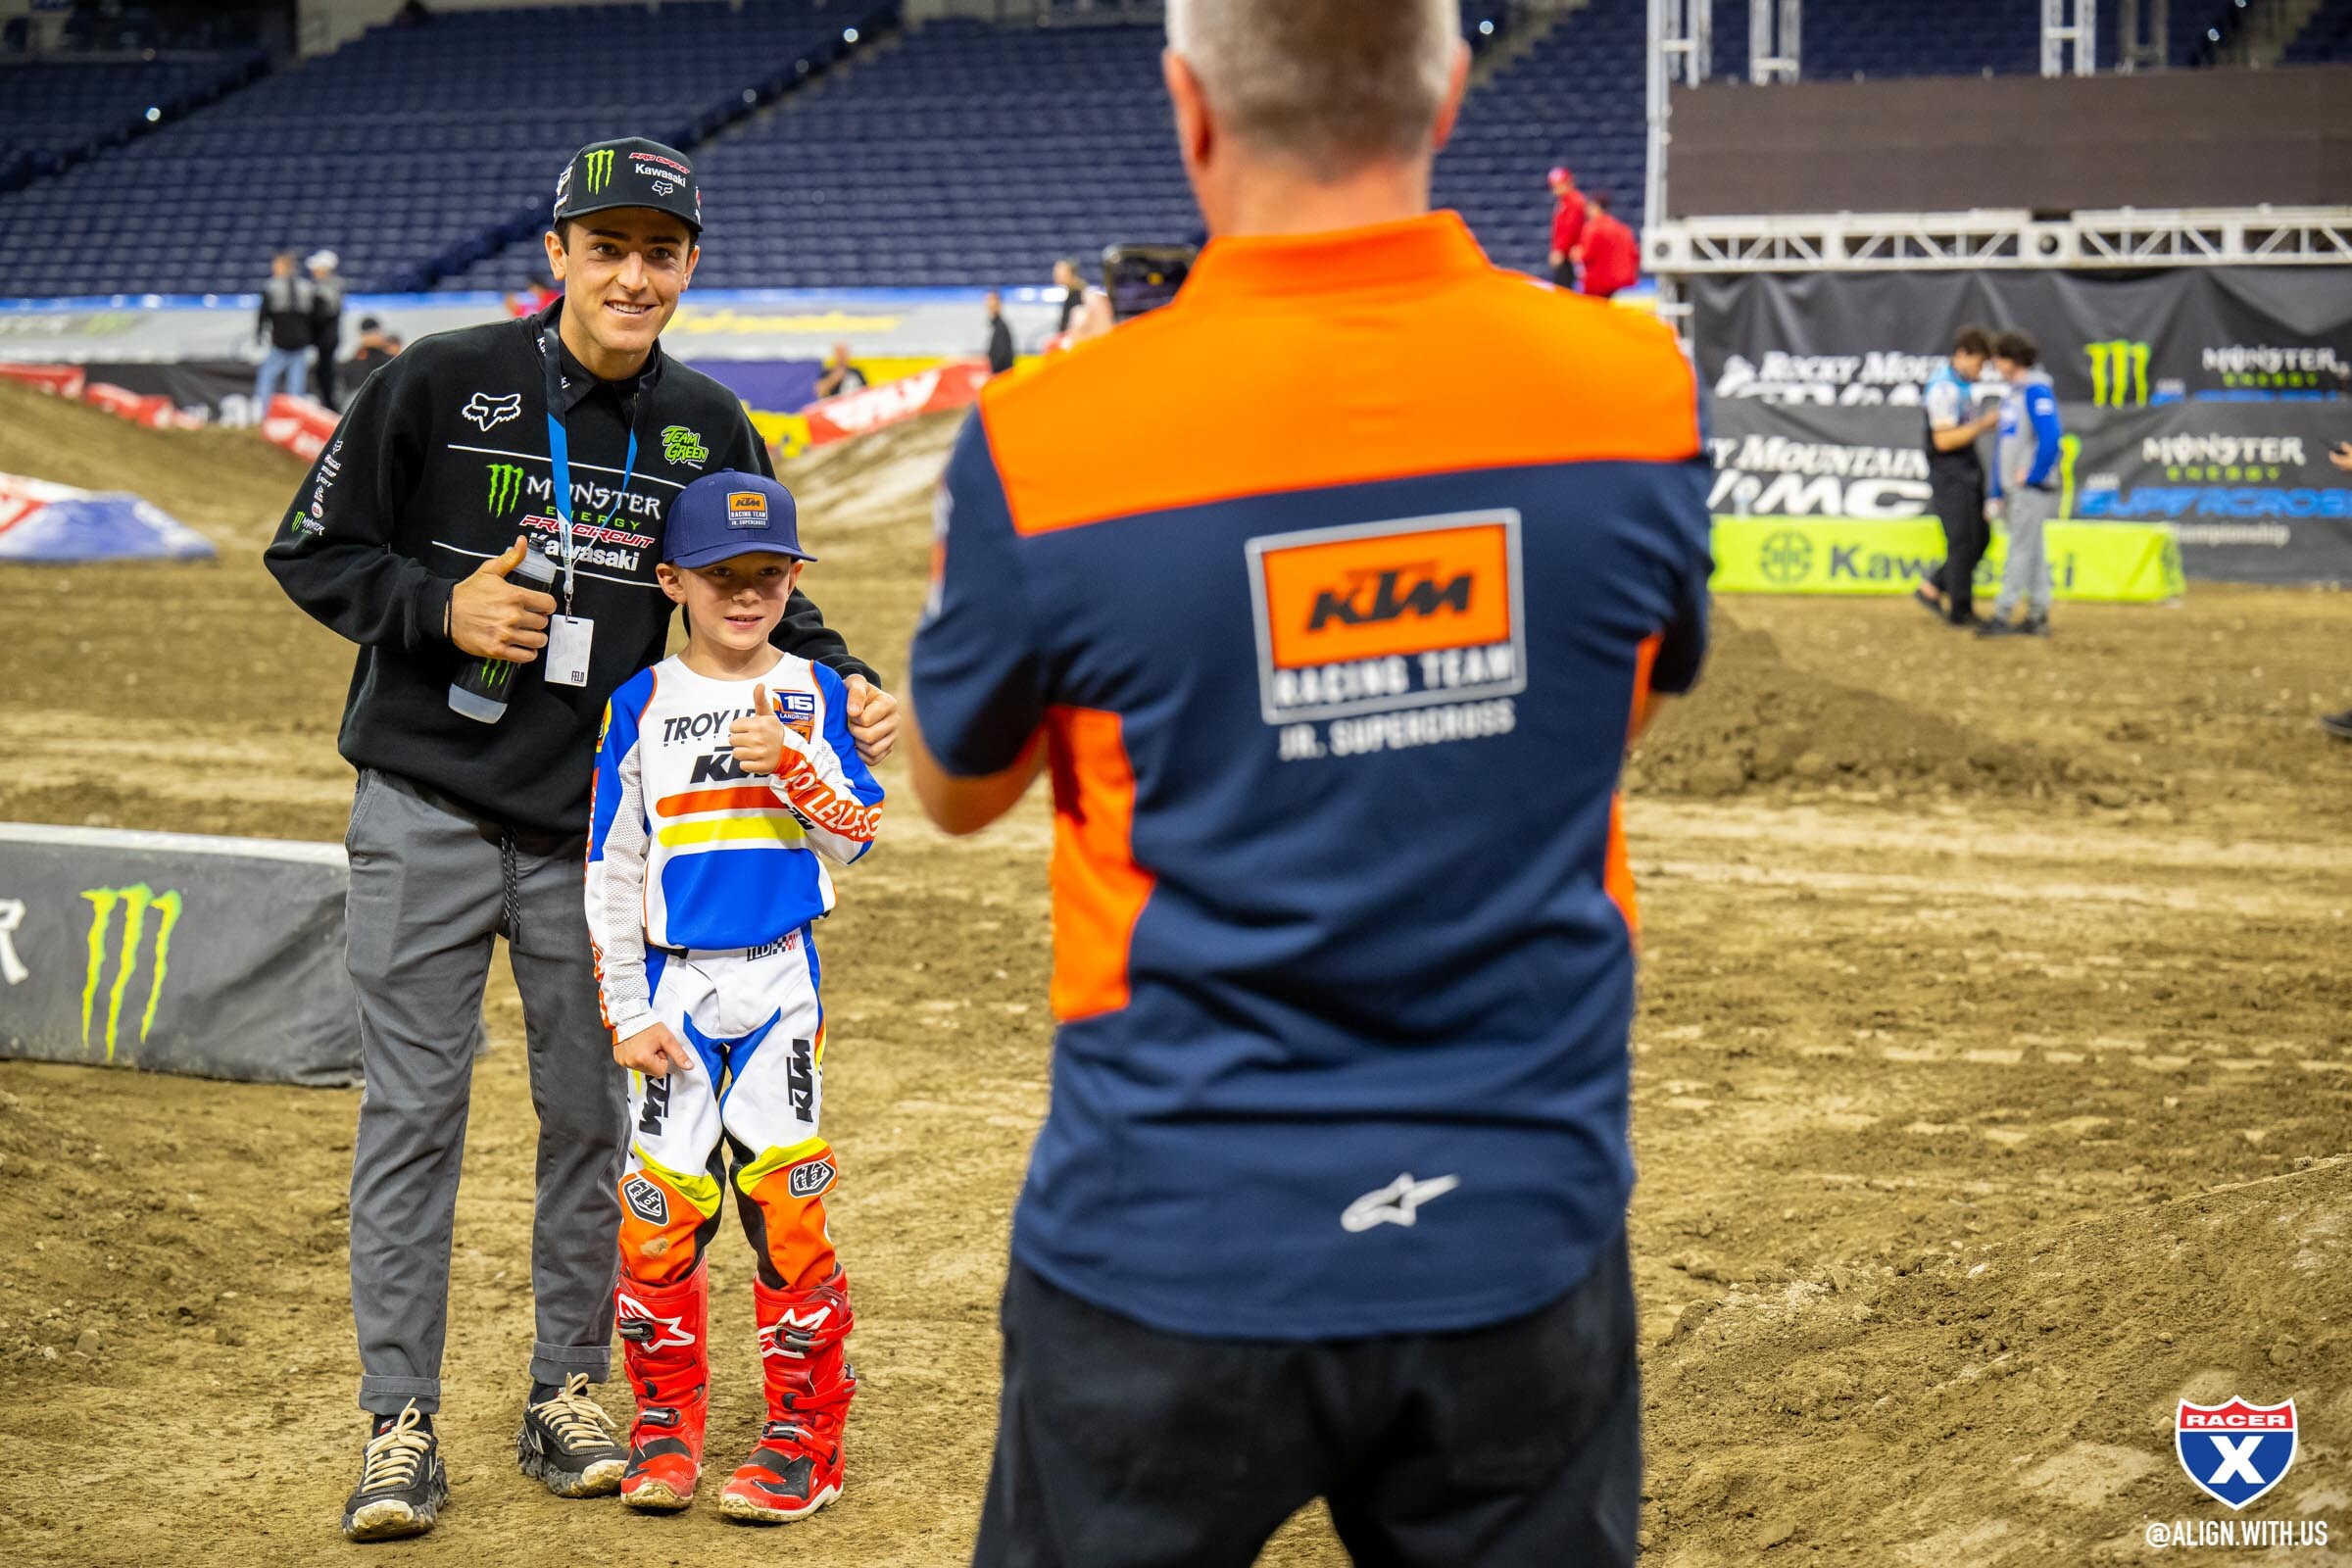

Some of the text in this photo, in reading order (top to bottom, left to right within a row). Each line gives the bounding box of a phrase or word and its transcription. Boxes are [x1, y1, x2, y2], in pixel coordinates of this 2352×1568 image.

[635, 163, 686, 188] Kawasaki
[2202, 344, 2350, 378] MONSTER
[662, 425, 701, 447] TEAM
[2141, 432, 2307, 466] MONSTER
[664, 443, 709, 465] GREEN
[1734, 434, 1932, 480] MOUNTAIN
[526, 474, 662, 520] MNSTER
[736, 498, 760, 507] KTM
[545, 505, 641, 531] EERGY
[571, 523, 656, 549] CIRCUIT
[1306, 560, 1474, 632] KTM
[570, 670, 585, 683] FELD
[1273, 642, 1516, 708] RACING TEAM
[779, 712, 809, 721] LANDRUM
[784, 695, 813, 711] 15
[663, 710, 730, 743] TROY
[1277, 697, 1517, 762] JR. SUPERCROSS
[786, 1038, 813, 1123] KTM
